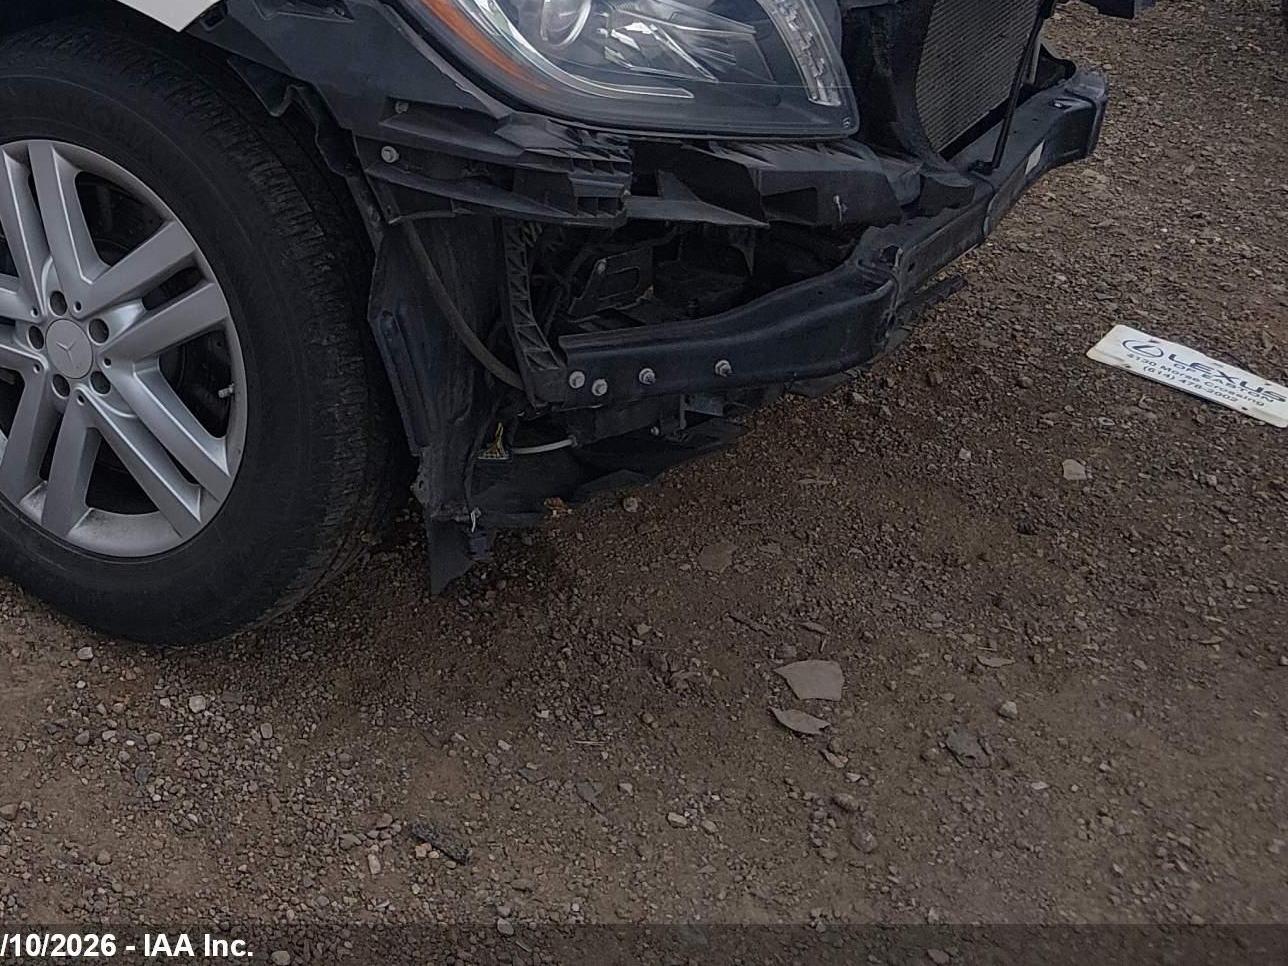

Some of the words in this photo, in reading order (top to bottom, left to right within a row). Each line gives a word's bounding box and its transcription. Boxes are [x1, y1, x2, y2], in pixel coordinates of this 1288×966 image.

[1126, 353, 1157, 367] 4130
[1160, 365, 1201, 383] Morse
[1204, 381, 1265, 407] Crossing
[1143, 366, 1175, 381] (614)
[1169, 353, 1287, 403] LEXUS
[1173, 363, 1197, 374] OF
[1200, 373, 1274, 403] EASTON
